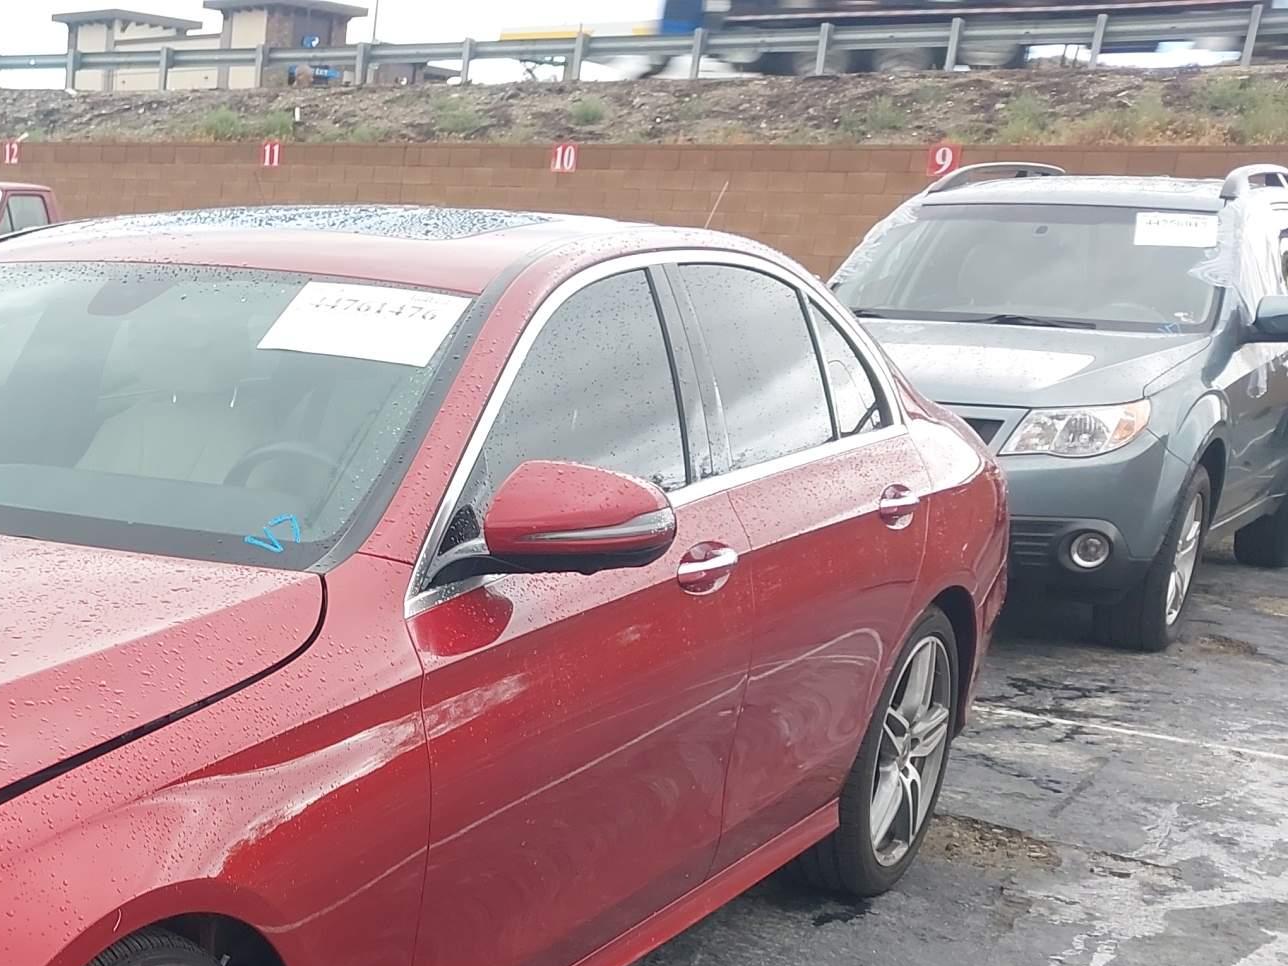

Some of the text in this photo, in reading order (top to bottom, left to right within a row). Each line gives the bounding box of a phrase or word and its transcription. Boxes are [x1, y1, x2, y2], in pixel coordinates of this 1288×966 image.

[4, 143, 19, 164] 12
[264, 143, 280, 166] 11
[555, 144, 575, 170] 10
[934, 147, 953, 174] 9
[309, 296, 438, 321] 44761476
